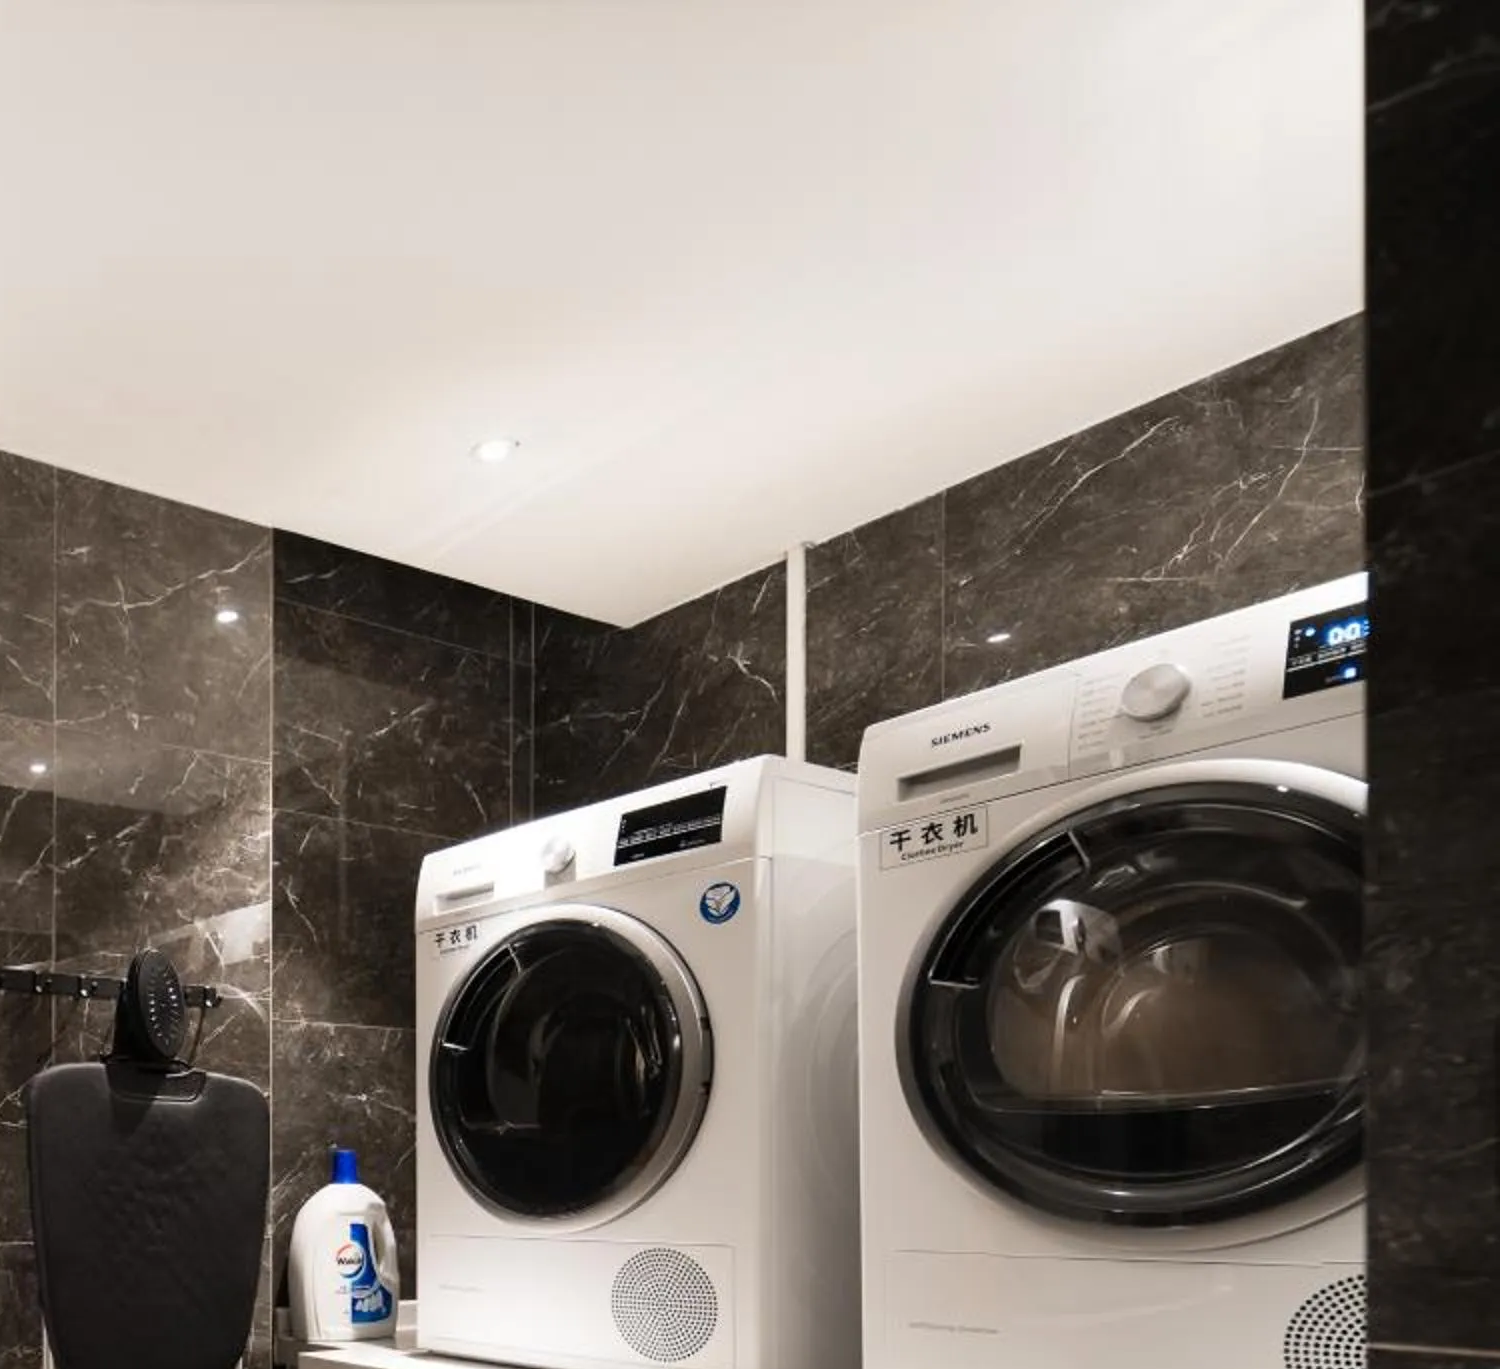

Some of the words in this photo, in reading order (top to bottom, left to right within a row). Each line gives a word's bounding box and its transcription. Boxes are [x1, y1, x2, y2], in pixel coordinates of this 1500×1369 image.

[931, 722, 991, 747] SIEMENS
[889, 813, 978, 852] 干衣机
[434, 925, 478, 948] 干衣机
